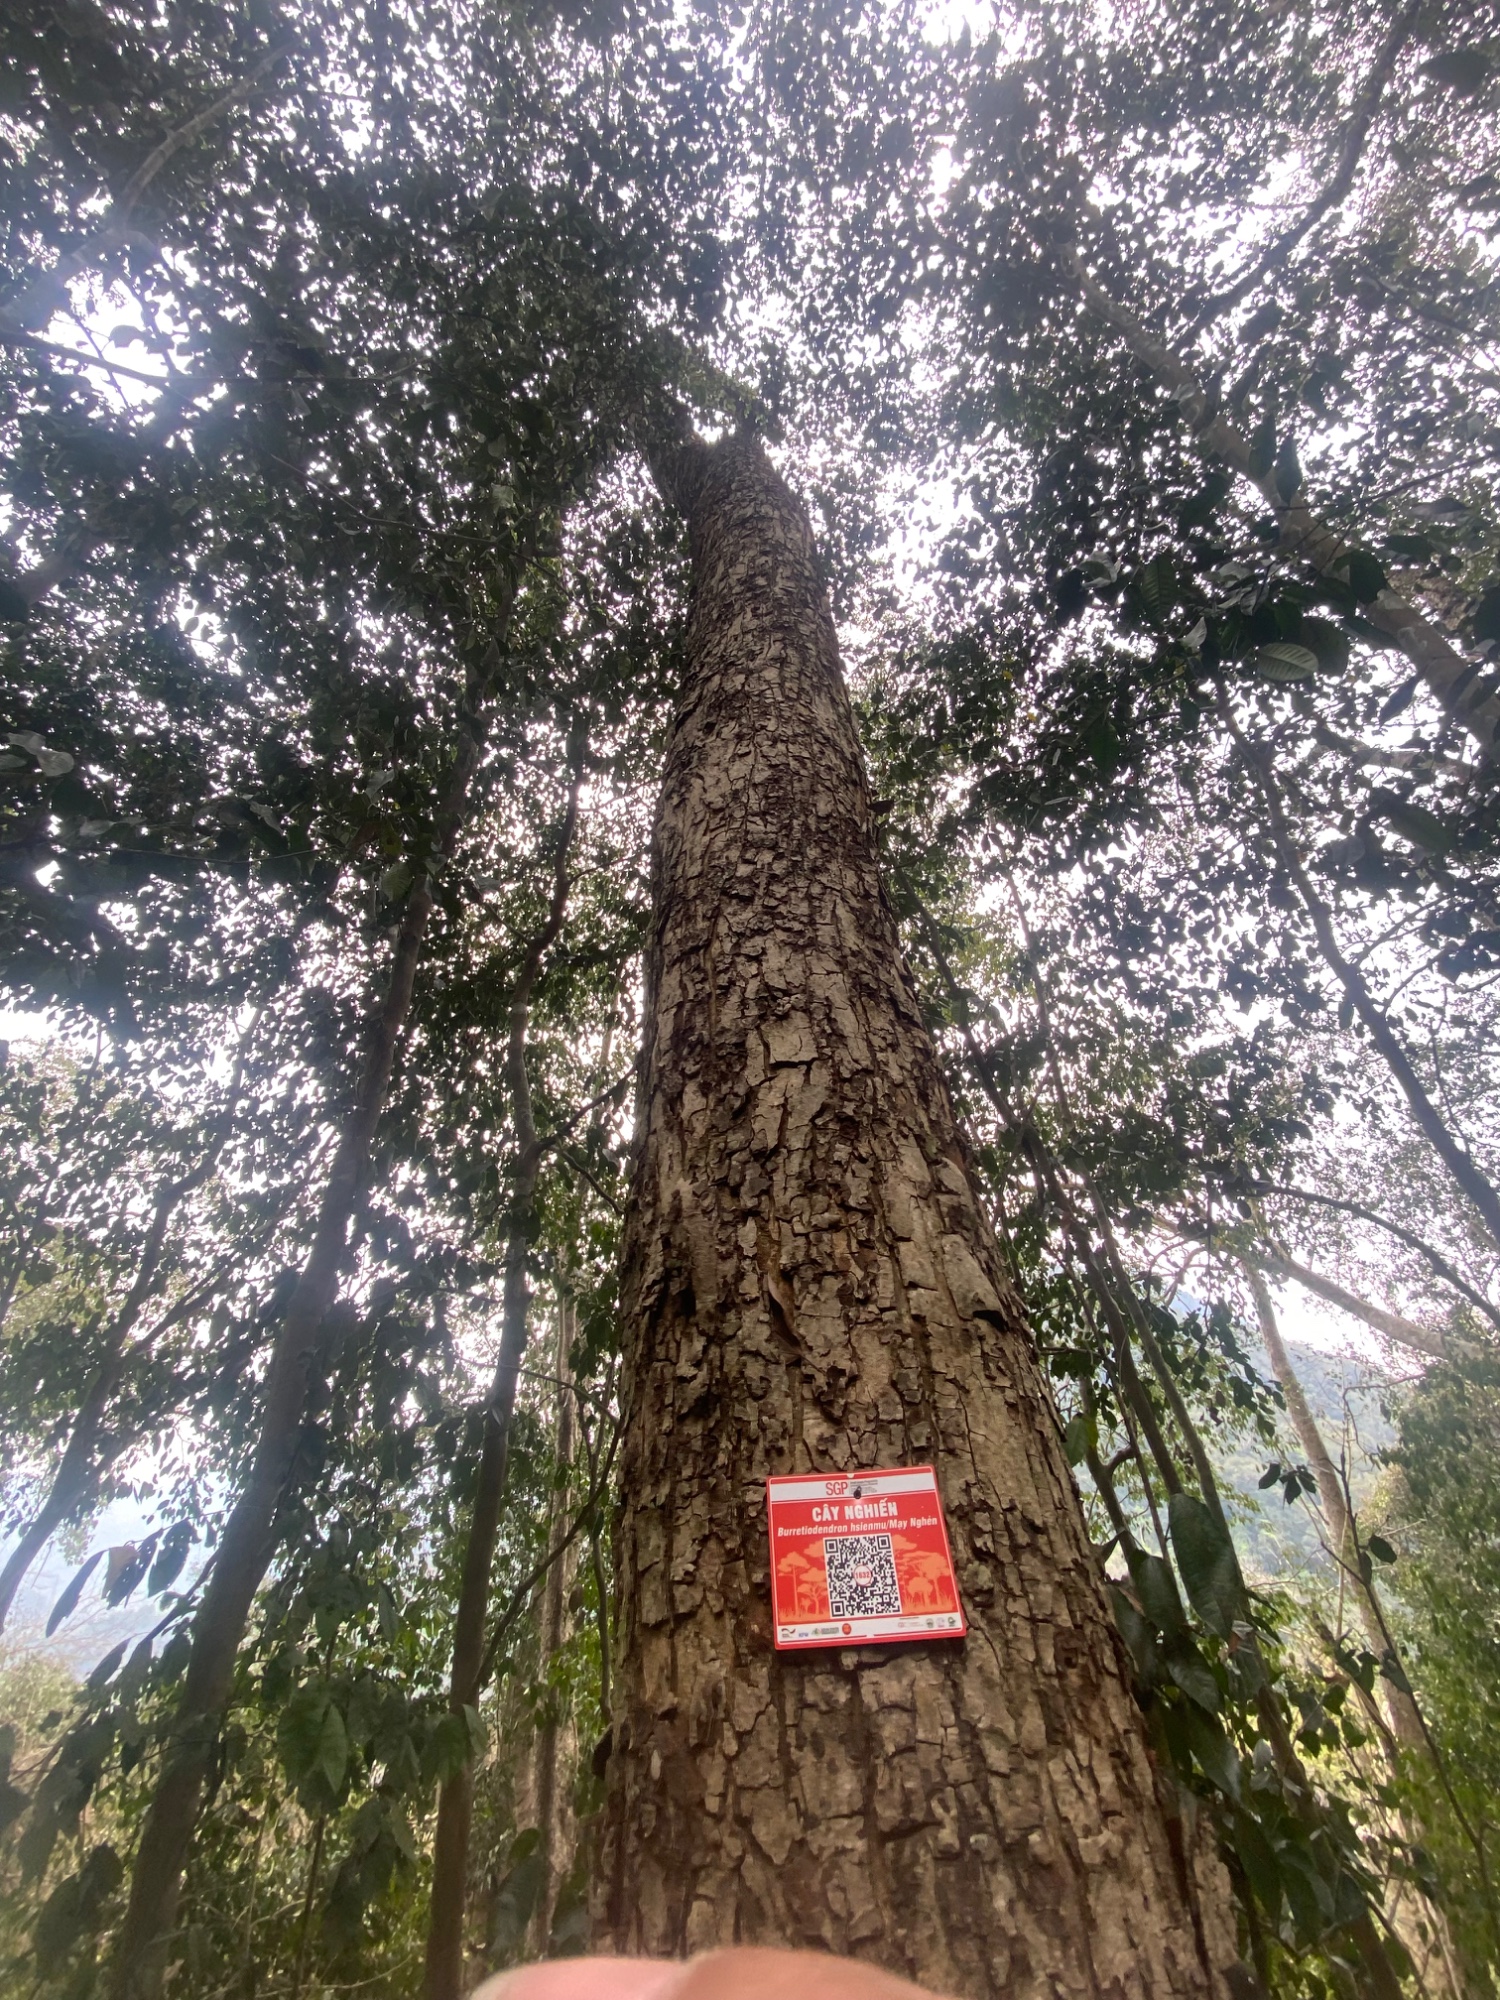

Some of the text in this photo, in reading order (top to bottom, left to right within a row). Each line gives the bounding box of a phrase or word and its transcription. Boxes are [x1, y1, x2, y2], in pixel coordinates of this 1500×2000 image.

[825, 1481, 848, 1496] SGP
[812, 1498, 899, 1522] CÂY NGHIẾN
[777, 1522, 848, 1537] Burretiodendron
